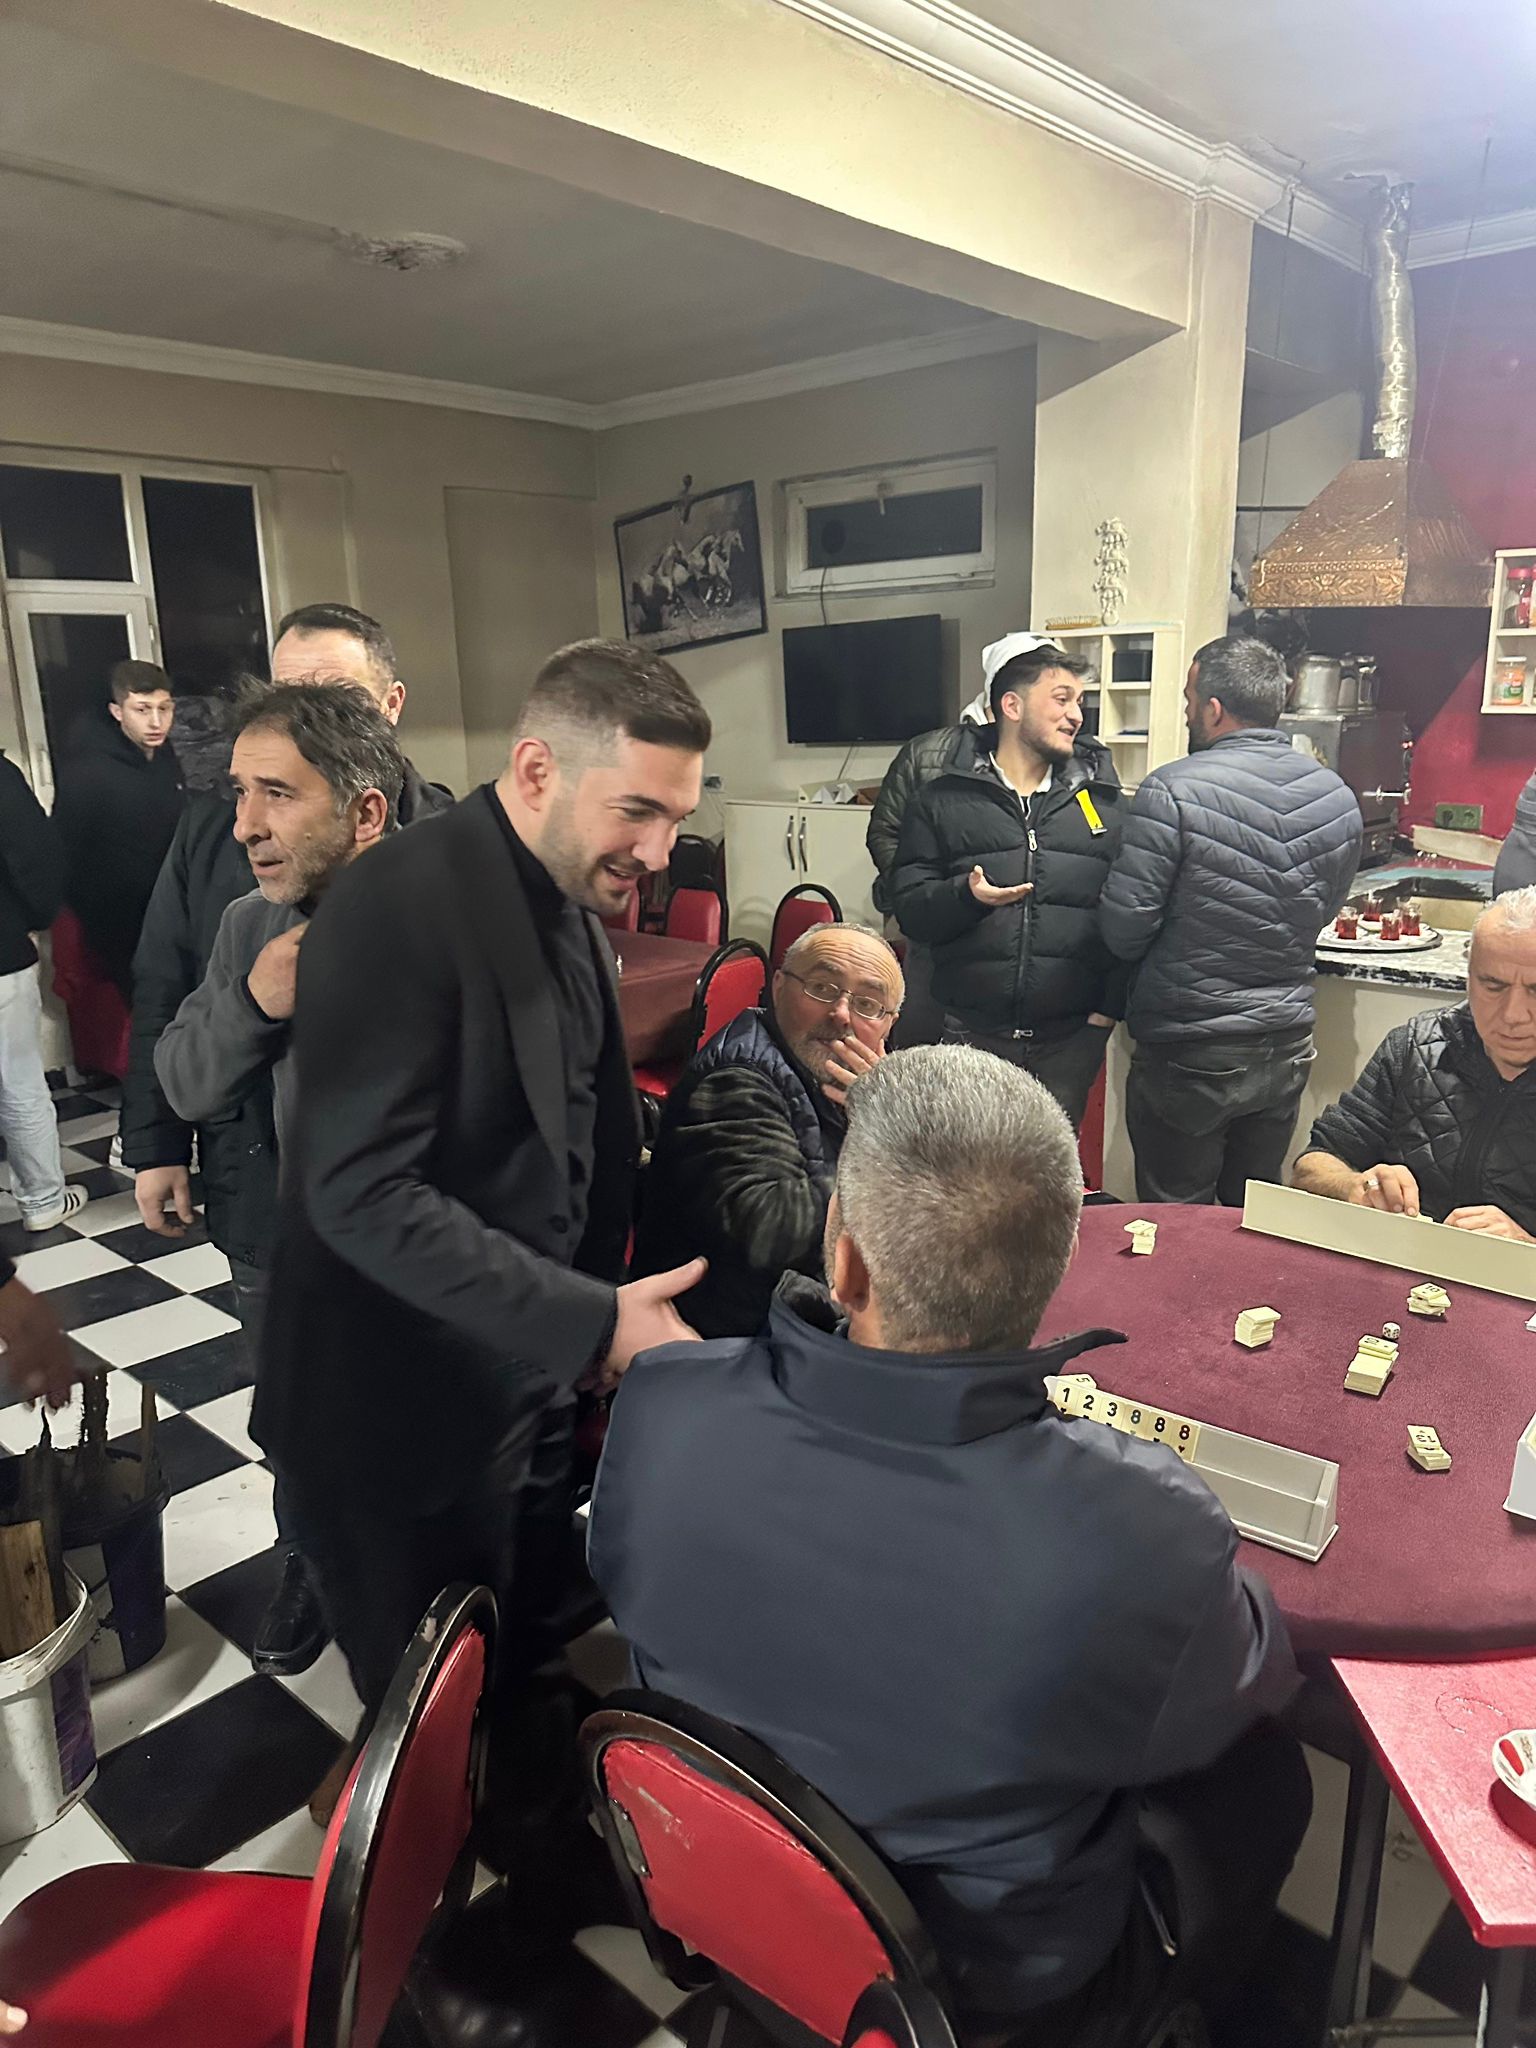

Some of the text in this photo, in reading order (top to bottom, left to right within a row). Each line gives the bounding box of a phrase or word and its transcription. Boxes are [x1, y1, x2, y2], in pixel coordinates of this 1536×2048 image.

[1062, 1387, 1190, 1440] 1 2 3 8 8 8
